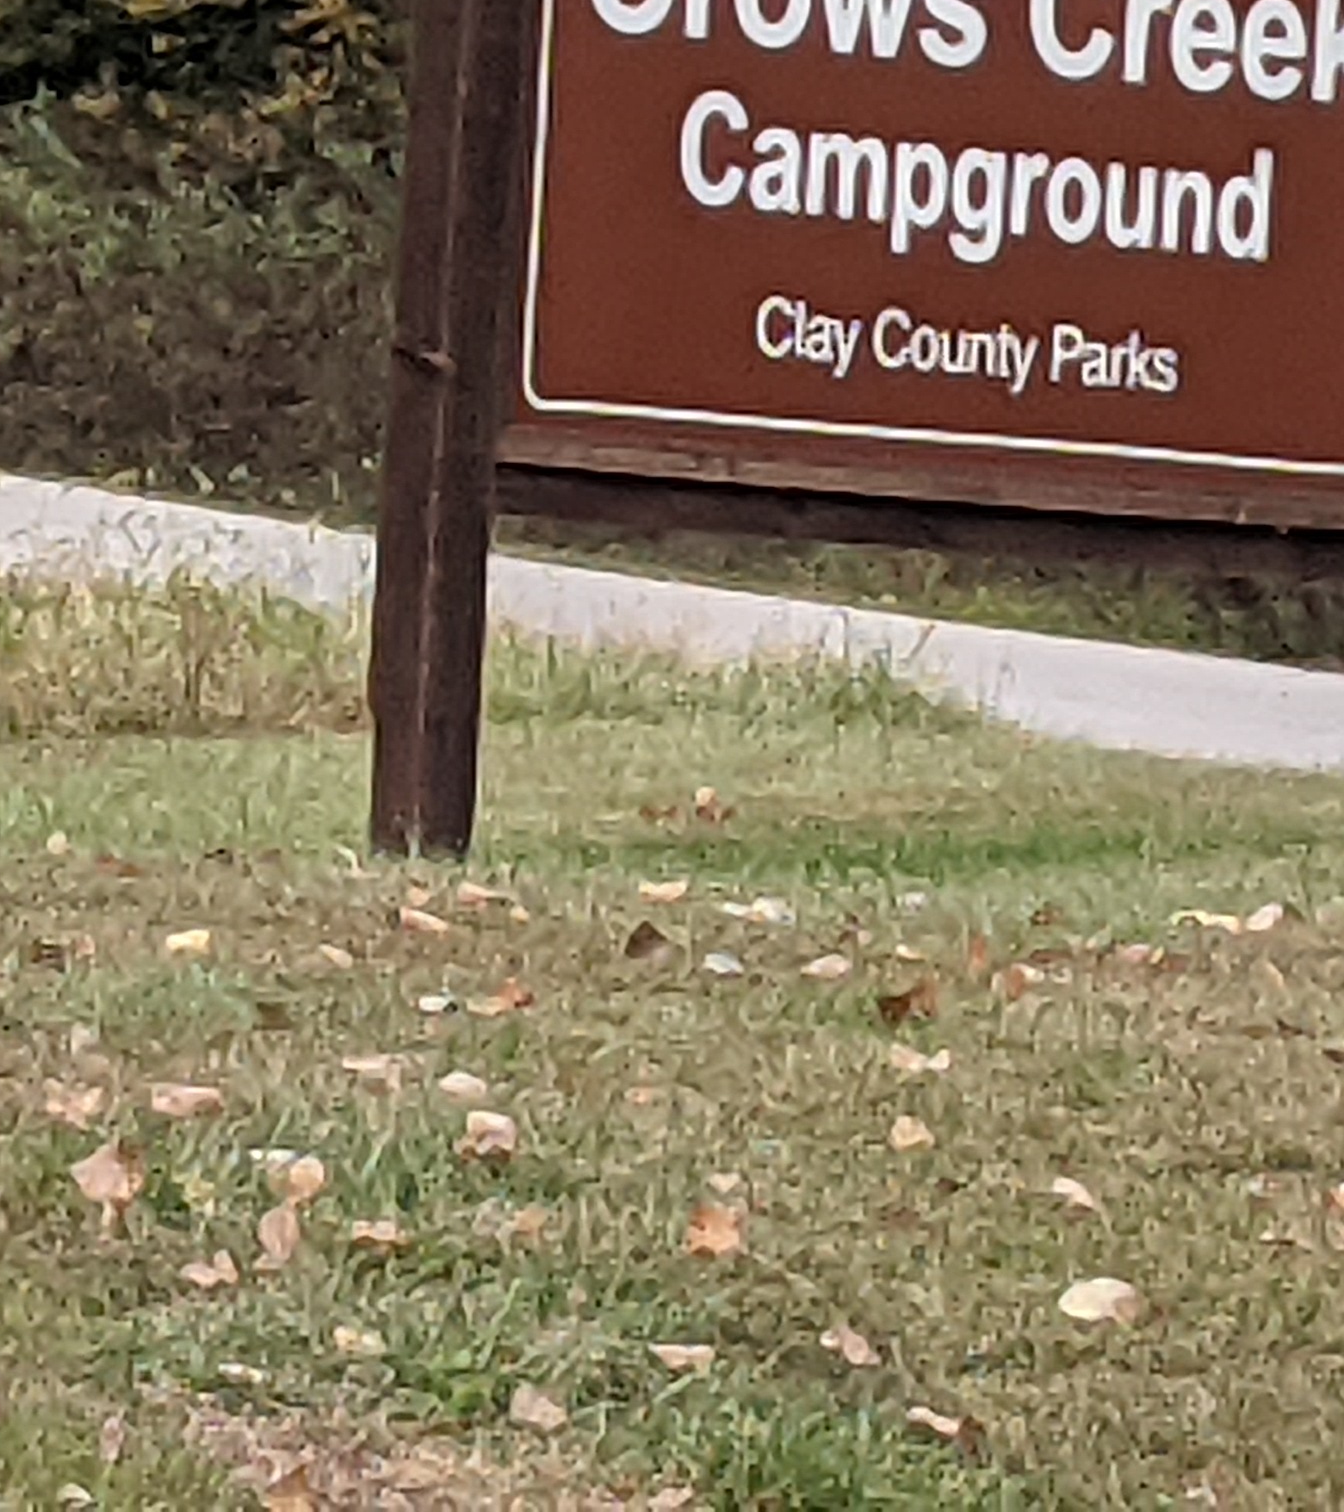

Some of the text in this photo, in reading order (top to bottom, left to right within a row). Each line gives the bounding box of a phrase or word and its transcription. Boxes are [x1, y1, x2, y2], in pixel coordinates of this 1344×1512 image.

[680, 90, 1274, 265] Campground
[756, 295, 1179, 395] Clay County Parks
